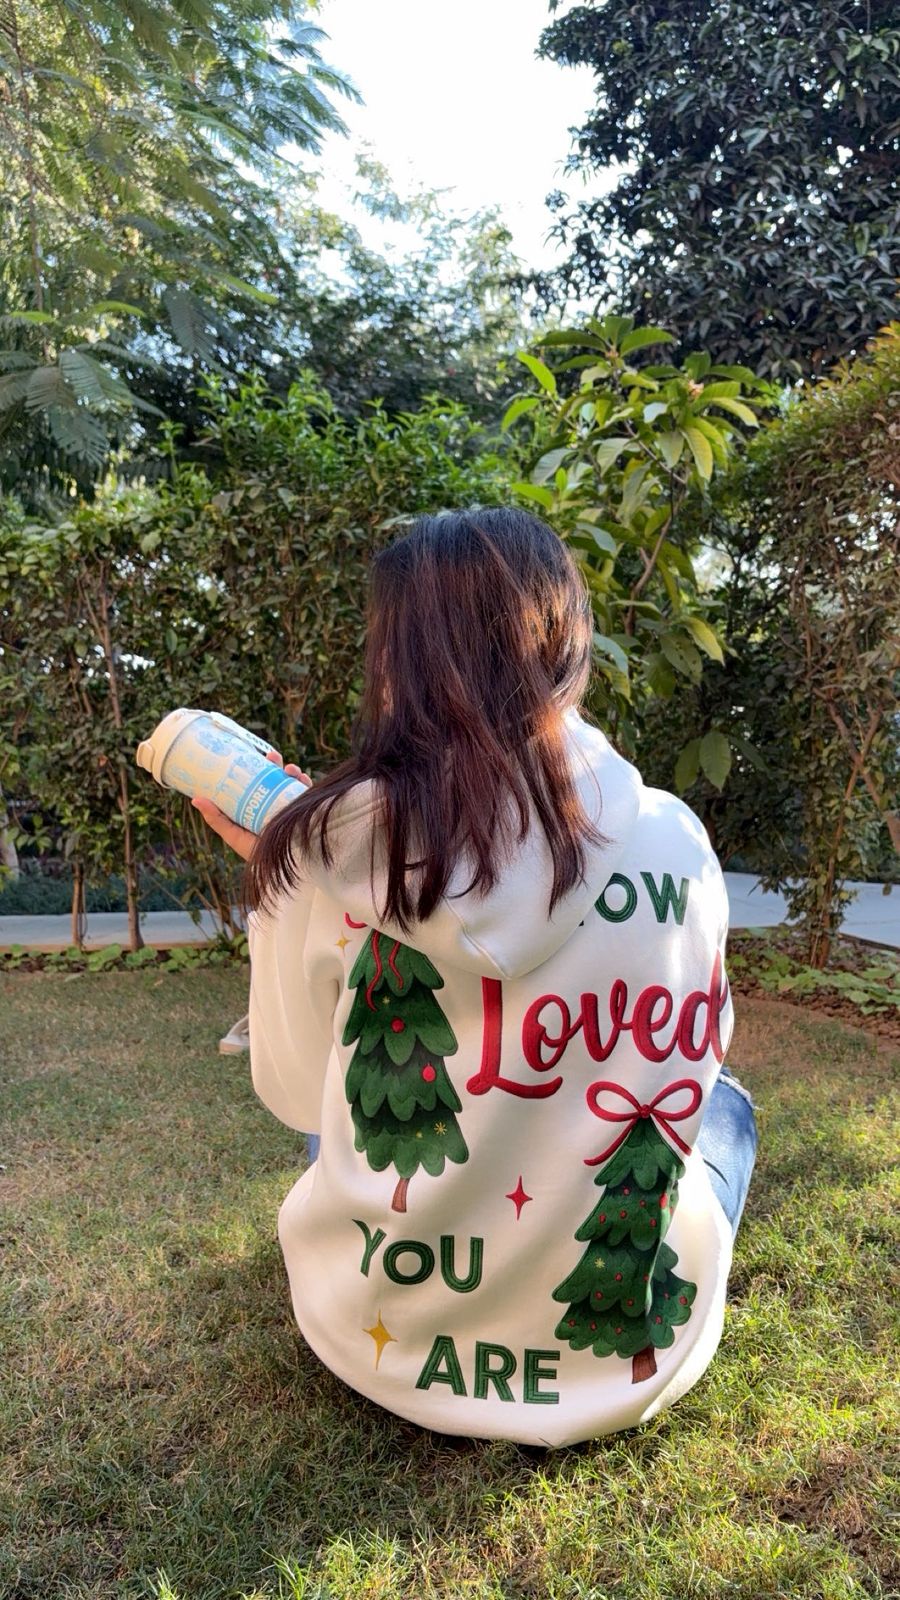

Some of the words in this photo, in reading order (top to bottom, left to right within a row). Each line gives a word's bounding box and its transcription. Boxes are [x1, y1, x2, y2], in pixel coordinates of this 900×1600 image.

[579, 871, 690, 926] OW
[466, 949, 728, 1099] Loved
[352, 1219, 484, 1293] YOU
[415, 1334, 561, 1405] ARE
